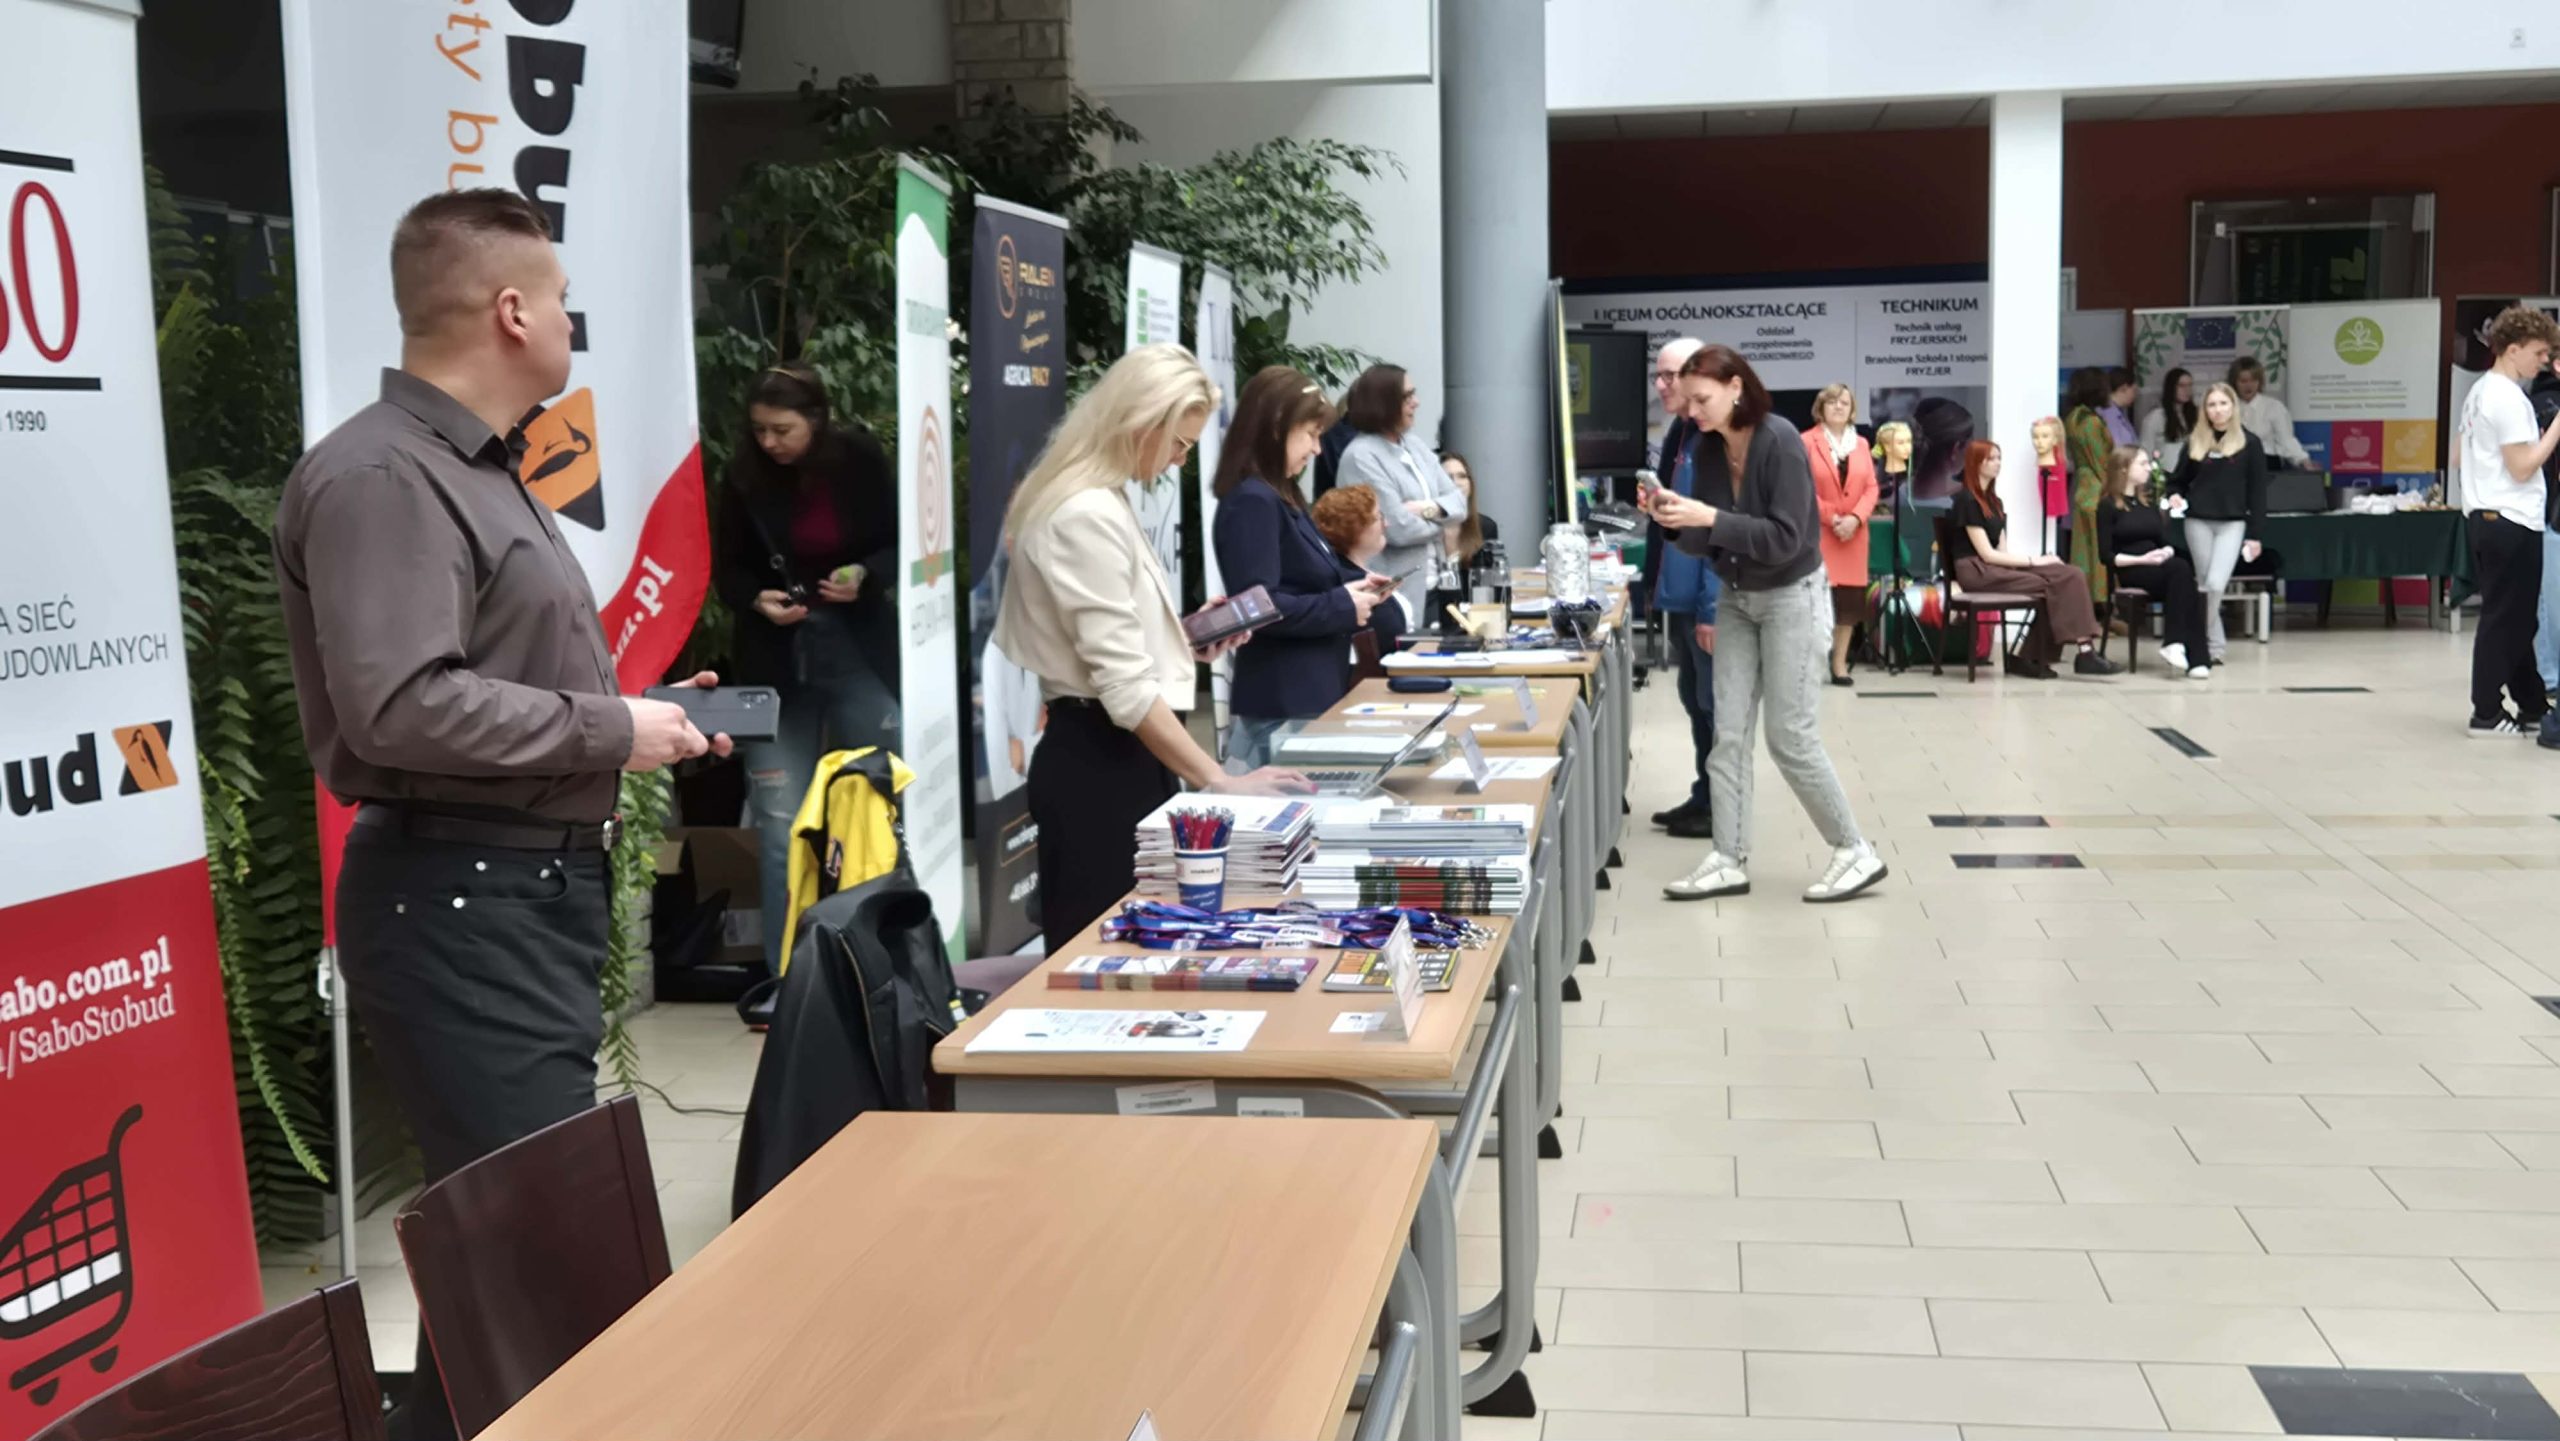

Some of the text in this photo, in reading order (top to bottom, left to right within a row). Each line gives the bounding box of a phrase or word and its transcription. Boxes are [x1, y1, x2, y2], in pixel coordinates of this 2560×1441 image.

[436, 0, 498, 190] ty bu
[0, 181, 79, 363] 0
[1594, 302, 1827, 322] LICEUM OGÓLNOKSZTAŁCĄCE
[1880, 297, 1979, 314] TECHNIKUM
[1757, 326, 1795, 336] Oddział
[1895, 322, 1931, 332] Technik
[1740, 339, 1813, 350] przygotowania
[1890, 334, 1967, 345] FRYZJERSKICH
[1956, 353, 1988, 363] stopni
[1905, 366, 1951, 376] FRYZJER
[6, 411, 46, 432] 1990
[17, 593, 76, 634] SIEĆ
[0, 732, 103, 817] ud
[0, 935, 172, 1022] abo.com.pl
